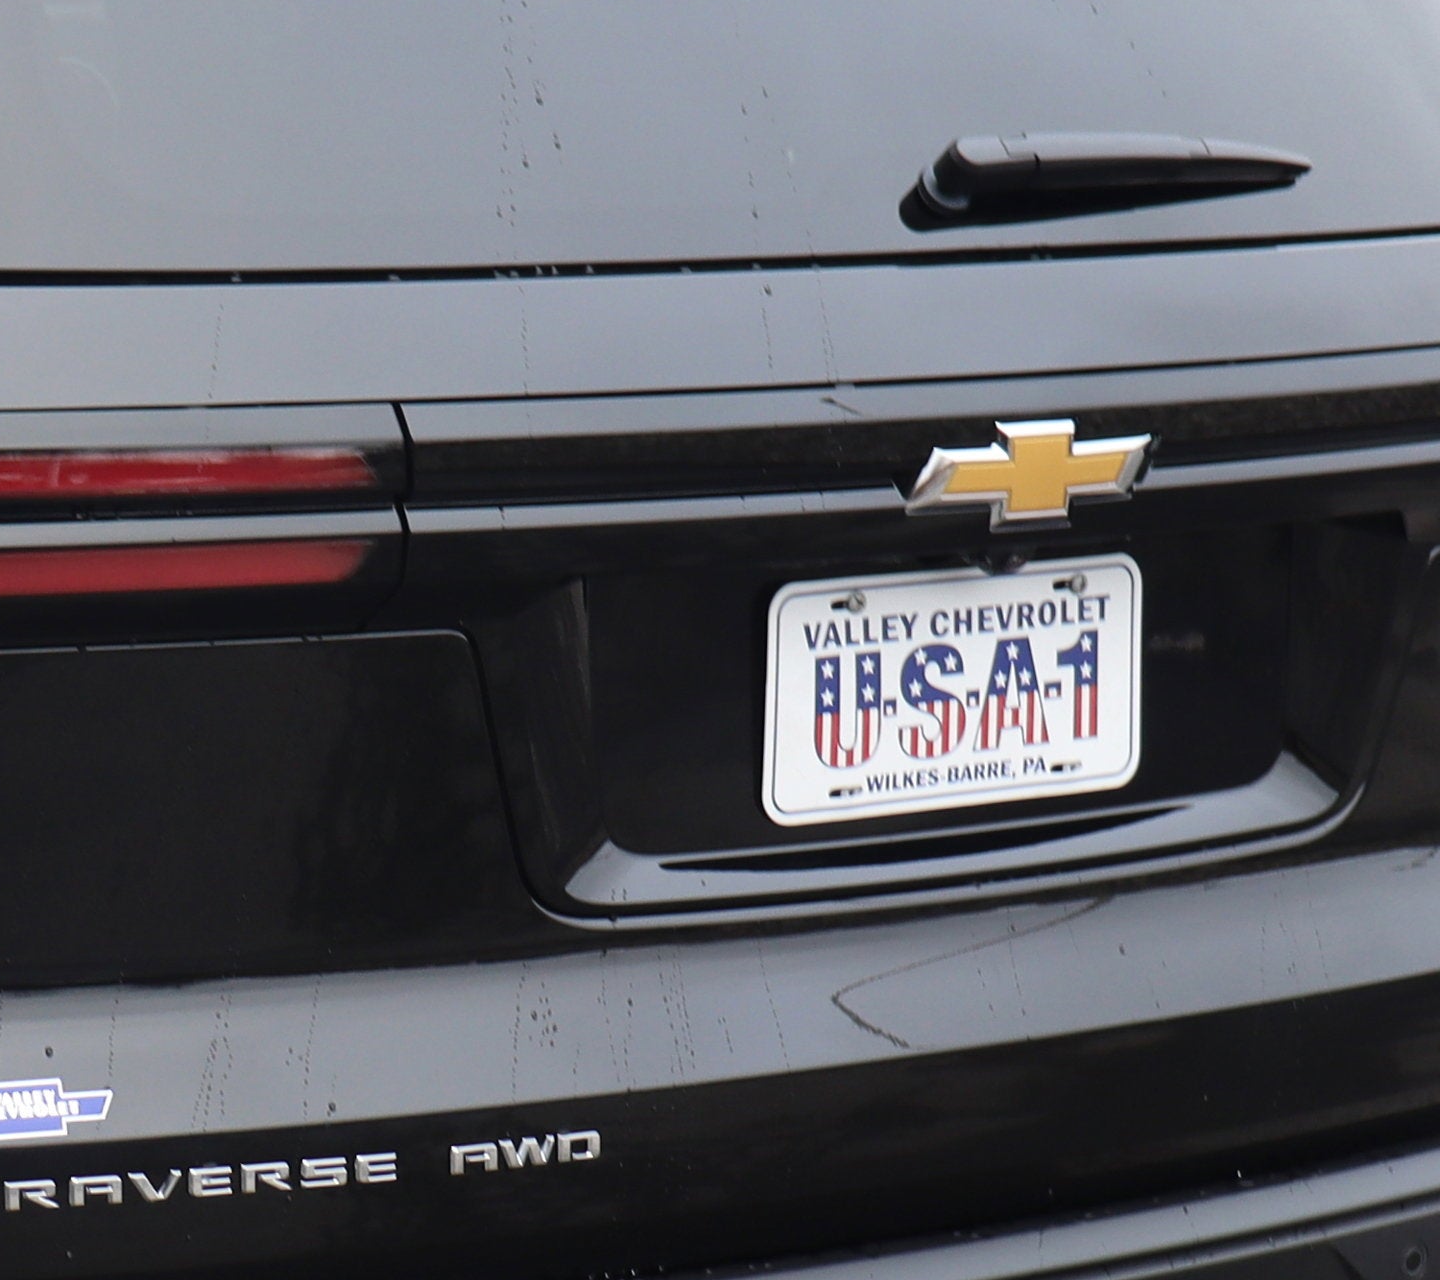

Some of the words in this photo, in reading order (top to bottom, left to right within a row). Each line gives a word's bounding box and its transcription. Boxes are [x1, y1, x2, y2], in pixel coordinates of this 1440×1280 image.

[803, 612, 918, 651] VALLEY
[929, 594, 1112, 638] CHEVROLET
[865, 761, 1017, 794] WILKES-BARRE,
[1022, 757, 1047, 777] PA
[449, 1129, 602, 1176] AWD
